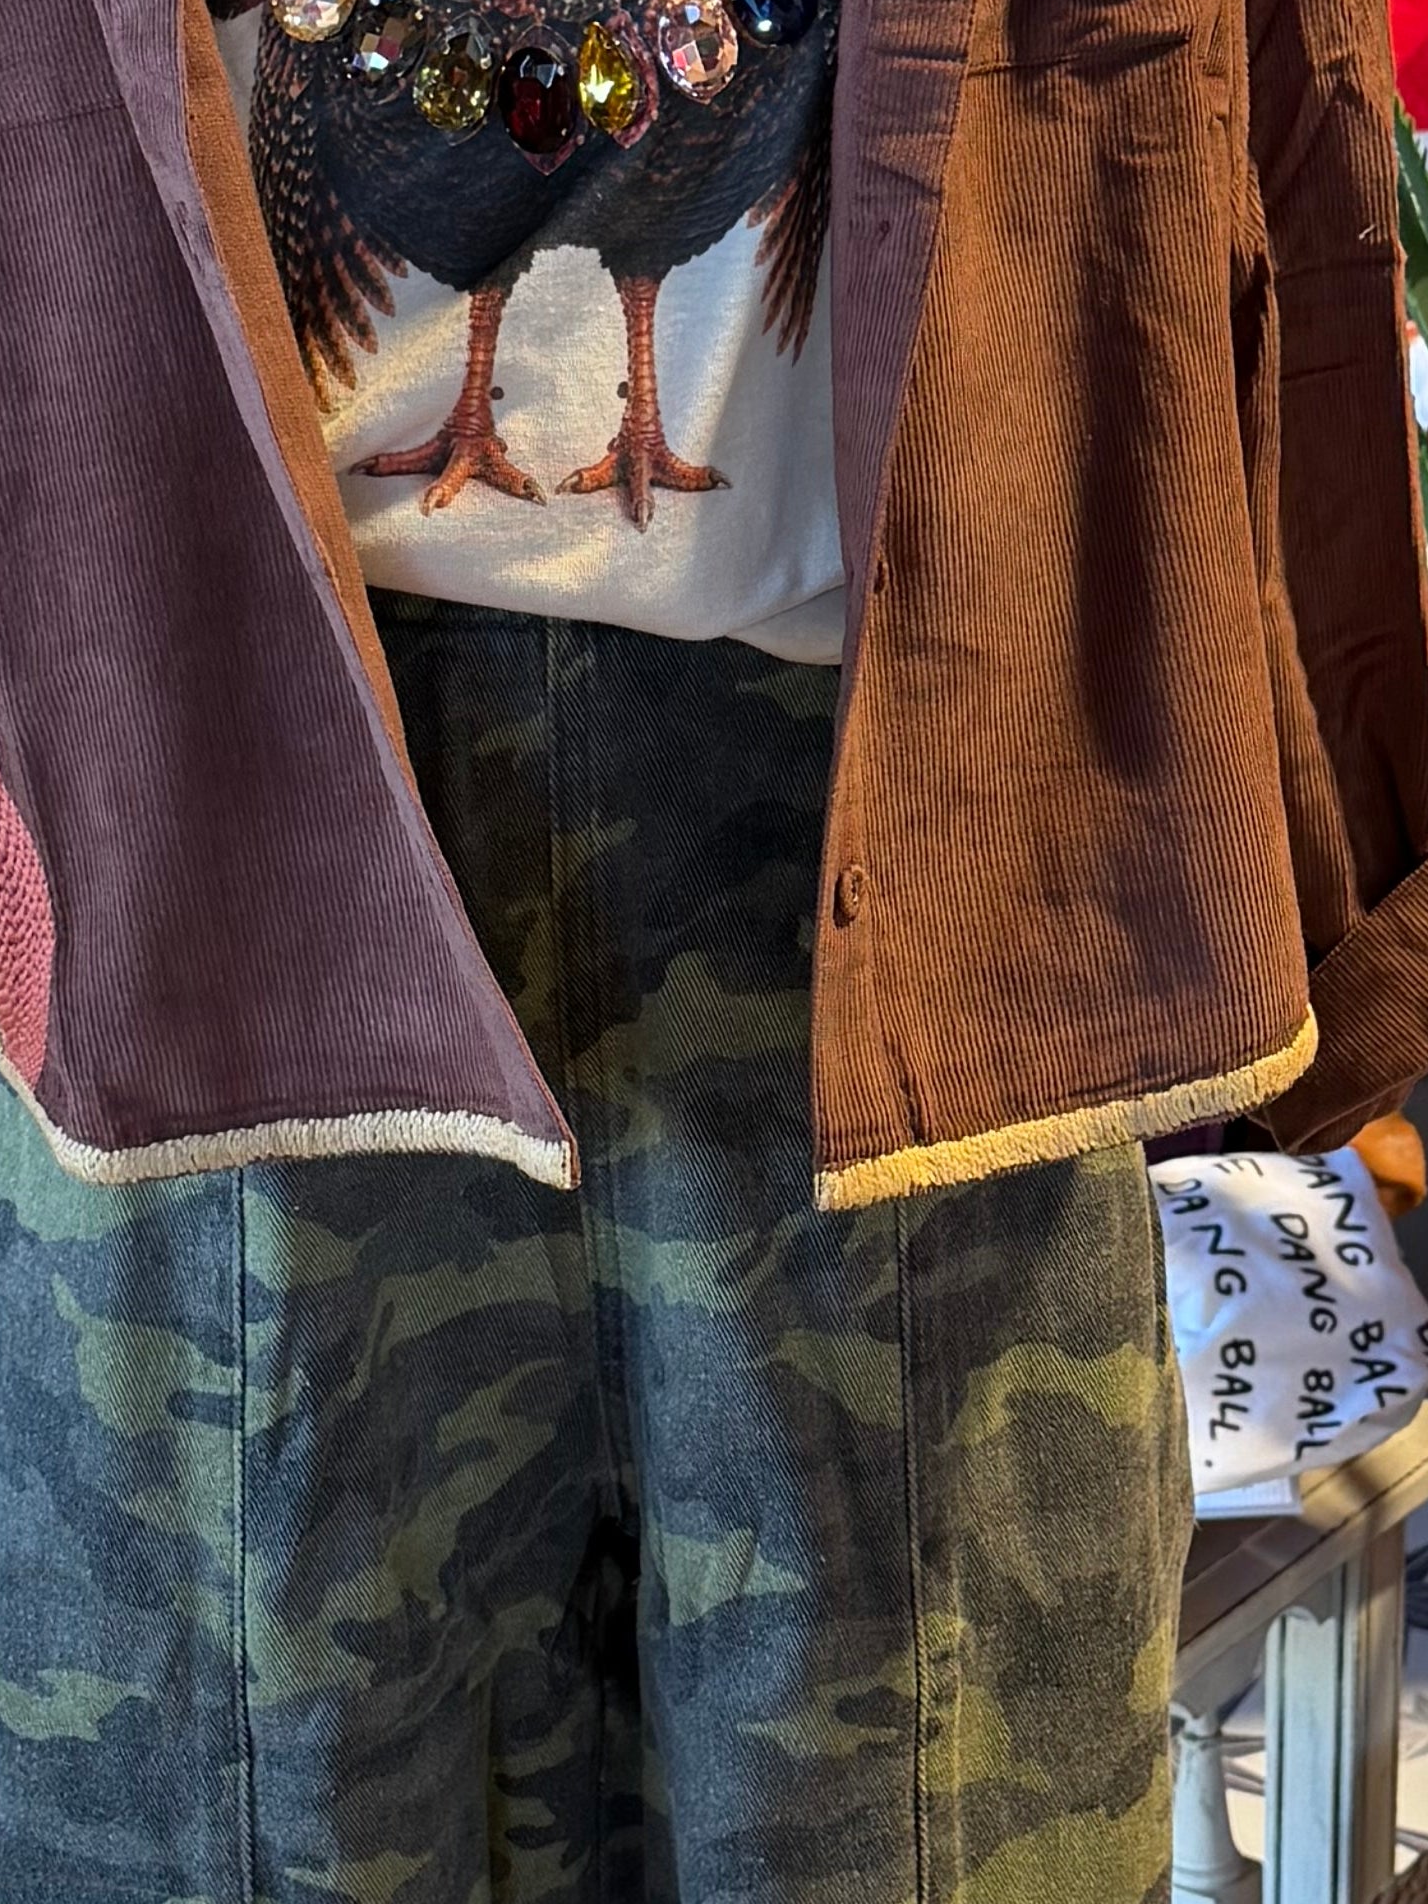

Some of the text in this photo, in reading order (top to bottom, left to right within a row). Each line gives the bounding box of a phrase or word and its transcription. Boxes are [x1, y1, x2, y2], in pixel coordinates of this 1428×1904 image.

[1157, 1178, 1247, 1296] DANG
[1270, 1212, 1338, 1335] DANG
[1294, 1367, 1343, 1461] BALL
[1349, 1320, 1408, 1423] BAL
